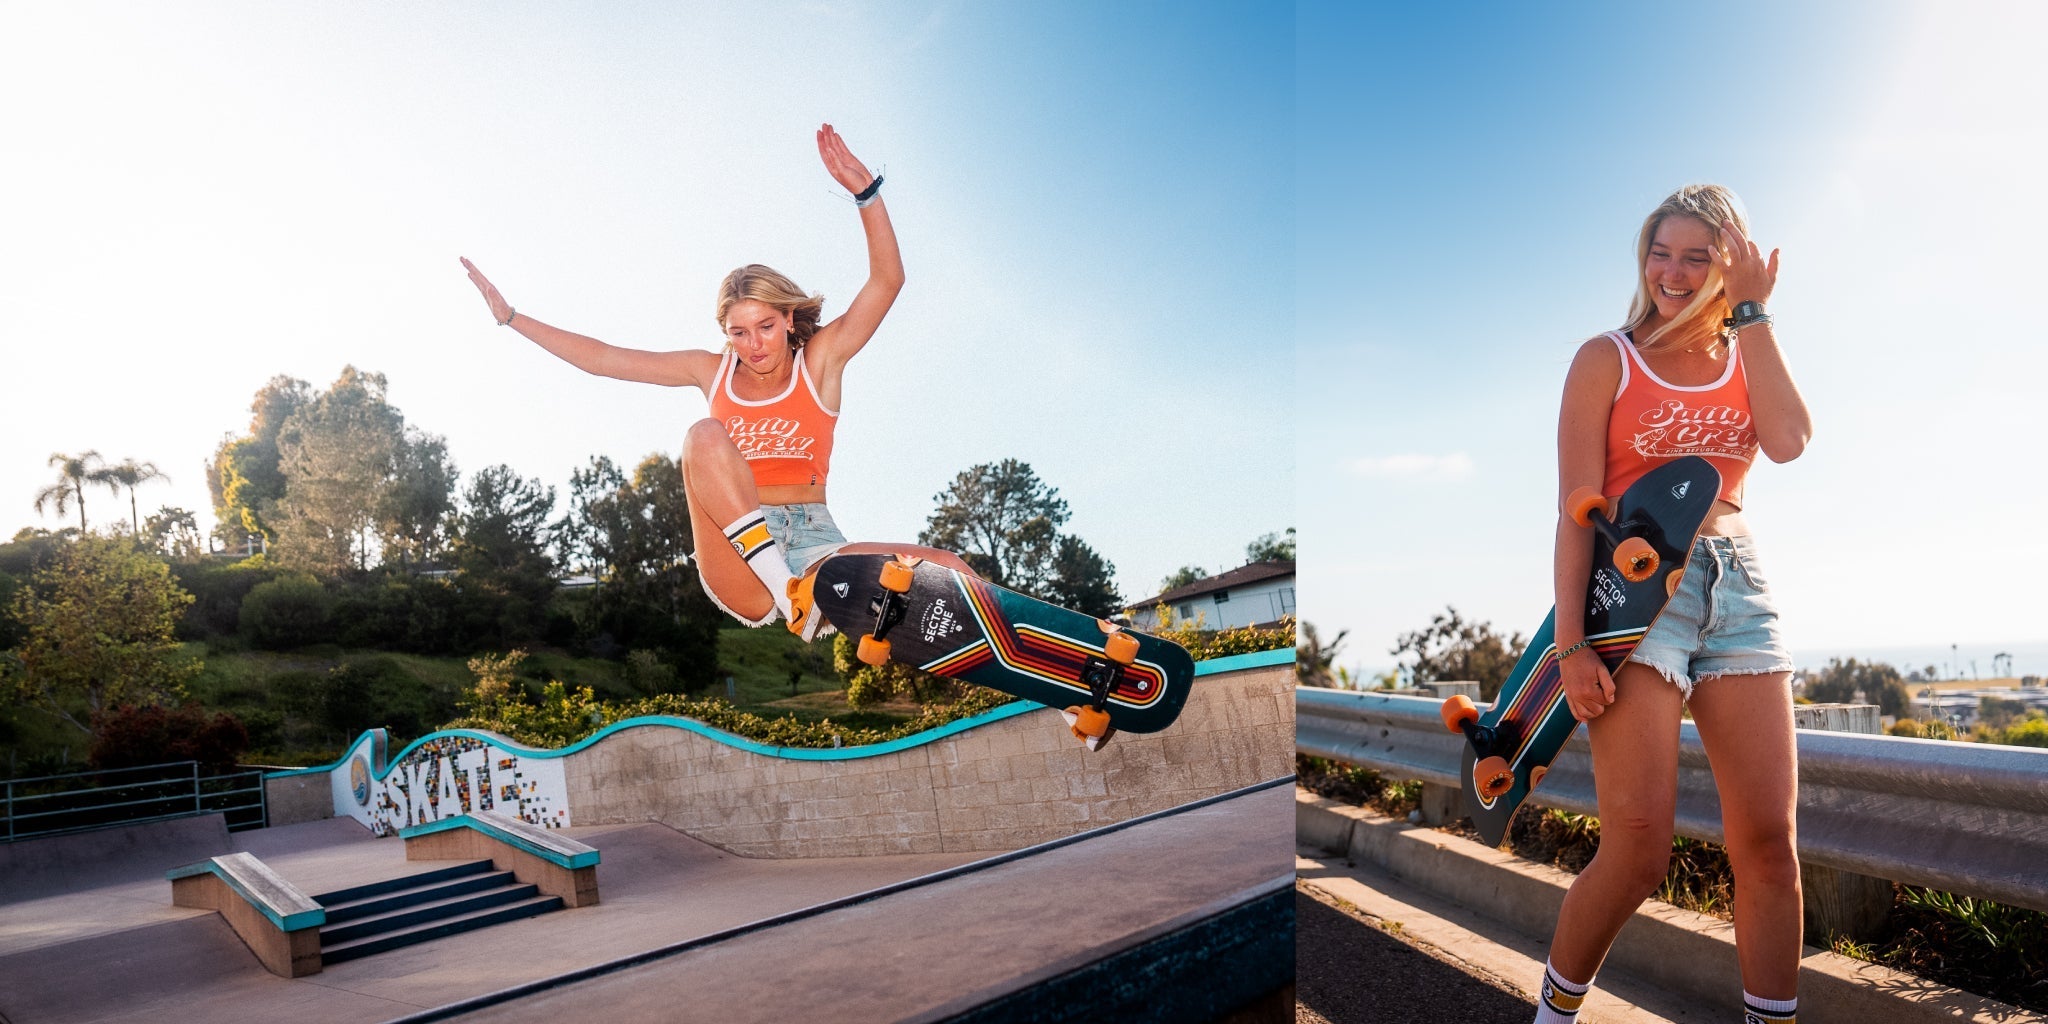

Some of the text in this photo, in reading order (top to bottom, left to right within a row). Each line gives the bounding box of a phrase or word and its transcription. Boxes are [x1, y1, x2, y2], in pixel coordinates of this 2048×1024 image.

[1639, 400, 1751, 429] Salty
[1593, 585, 1614, 611] NINE
[1594, 569, 1626, 608] SECTOR
[924, 598, 946, 642] SECTOR
[937, 610, 953, 637] NINE
[385, 746, 520, 829] SKATE
